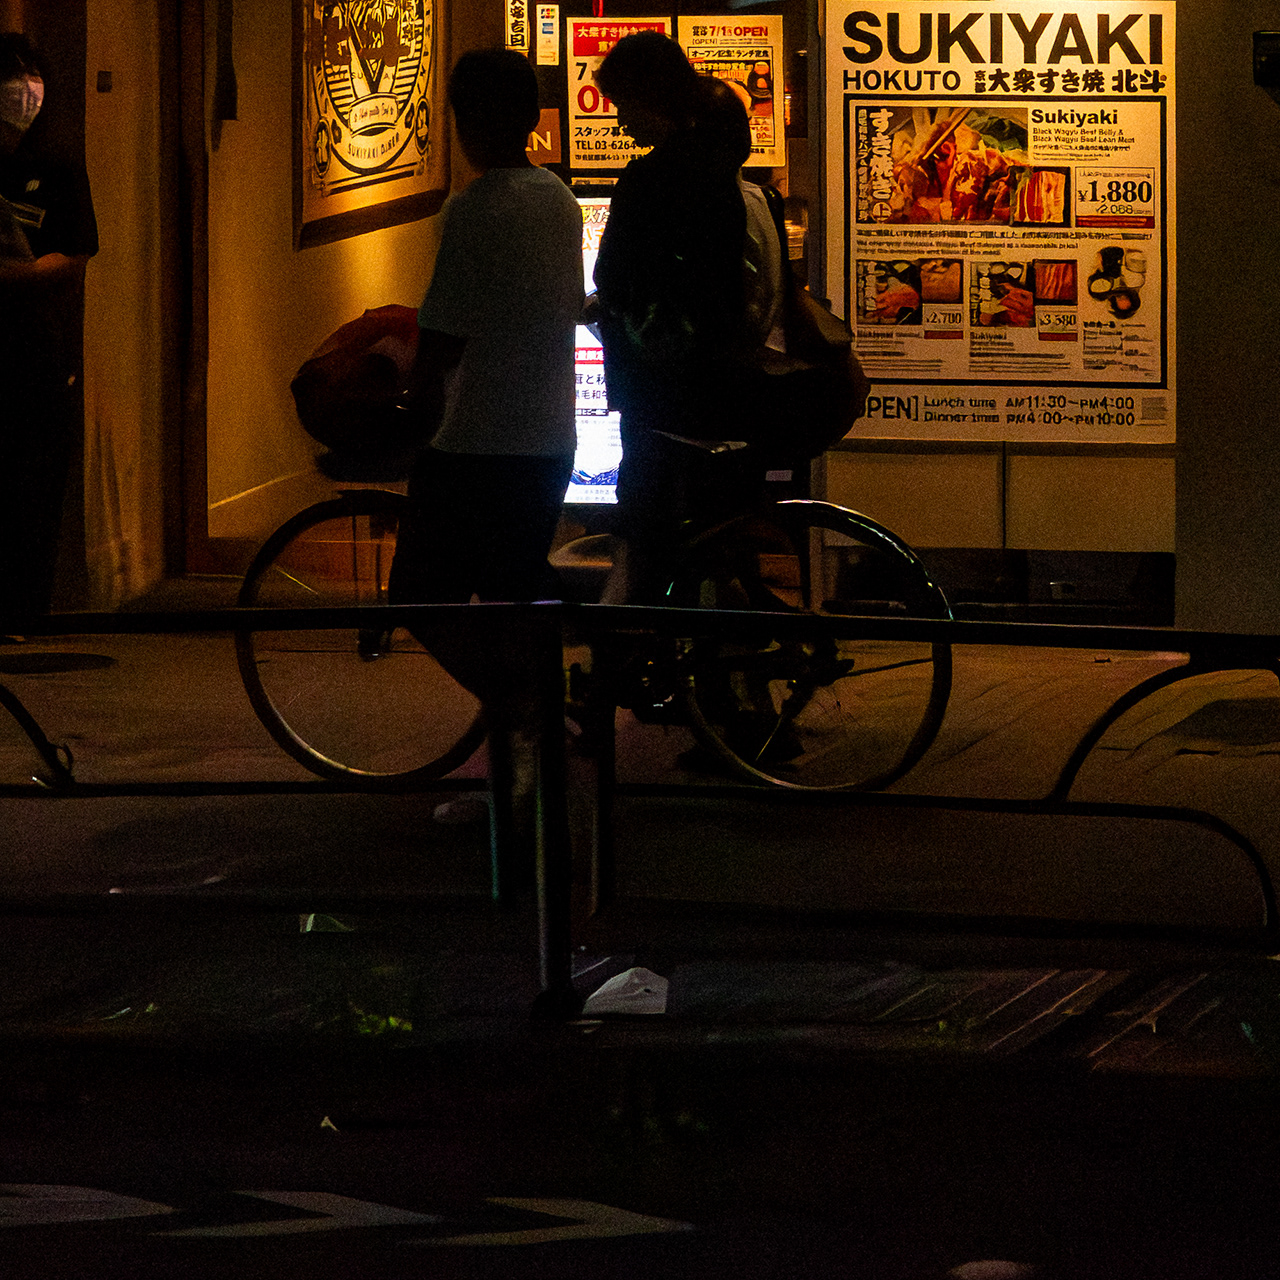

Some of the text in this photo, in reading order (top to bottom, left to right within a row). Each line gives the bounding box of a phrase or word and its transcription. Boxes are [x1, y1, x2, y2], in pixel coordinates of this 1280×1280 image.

[733, 26, 768, 37] OPEN
[842, 11, 1163, 65] SUKIYAKI
[842, 69, 961, 91] HOKUTO
[988, 68, 1106, 93] 大衆すき焼
[1111, 68, 1167, 93] 北斗
[1031, 109, 1118, 128] Sukiyaki
[1078, 180, 1153, 203] ¥1,880
[867, 395, 919, 422] PEN]
[924, 395, 965, 408] Lunch
[924, 411, 968, 422] Dinner
